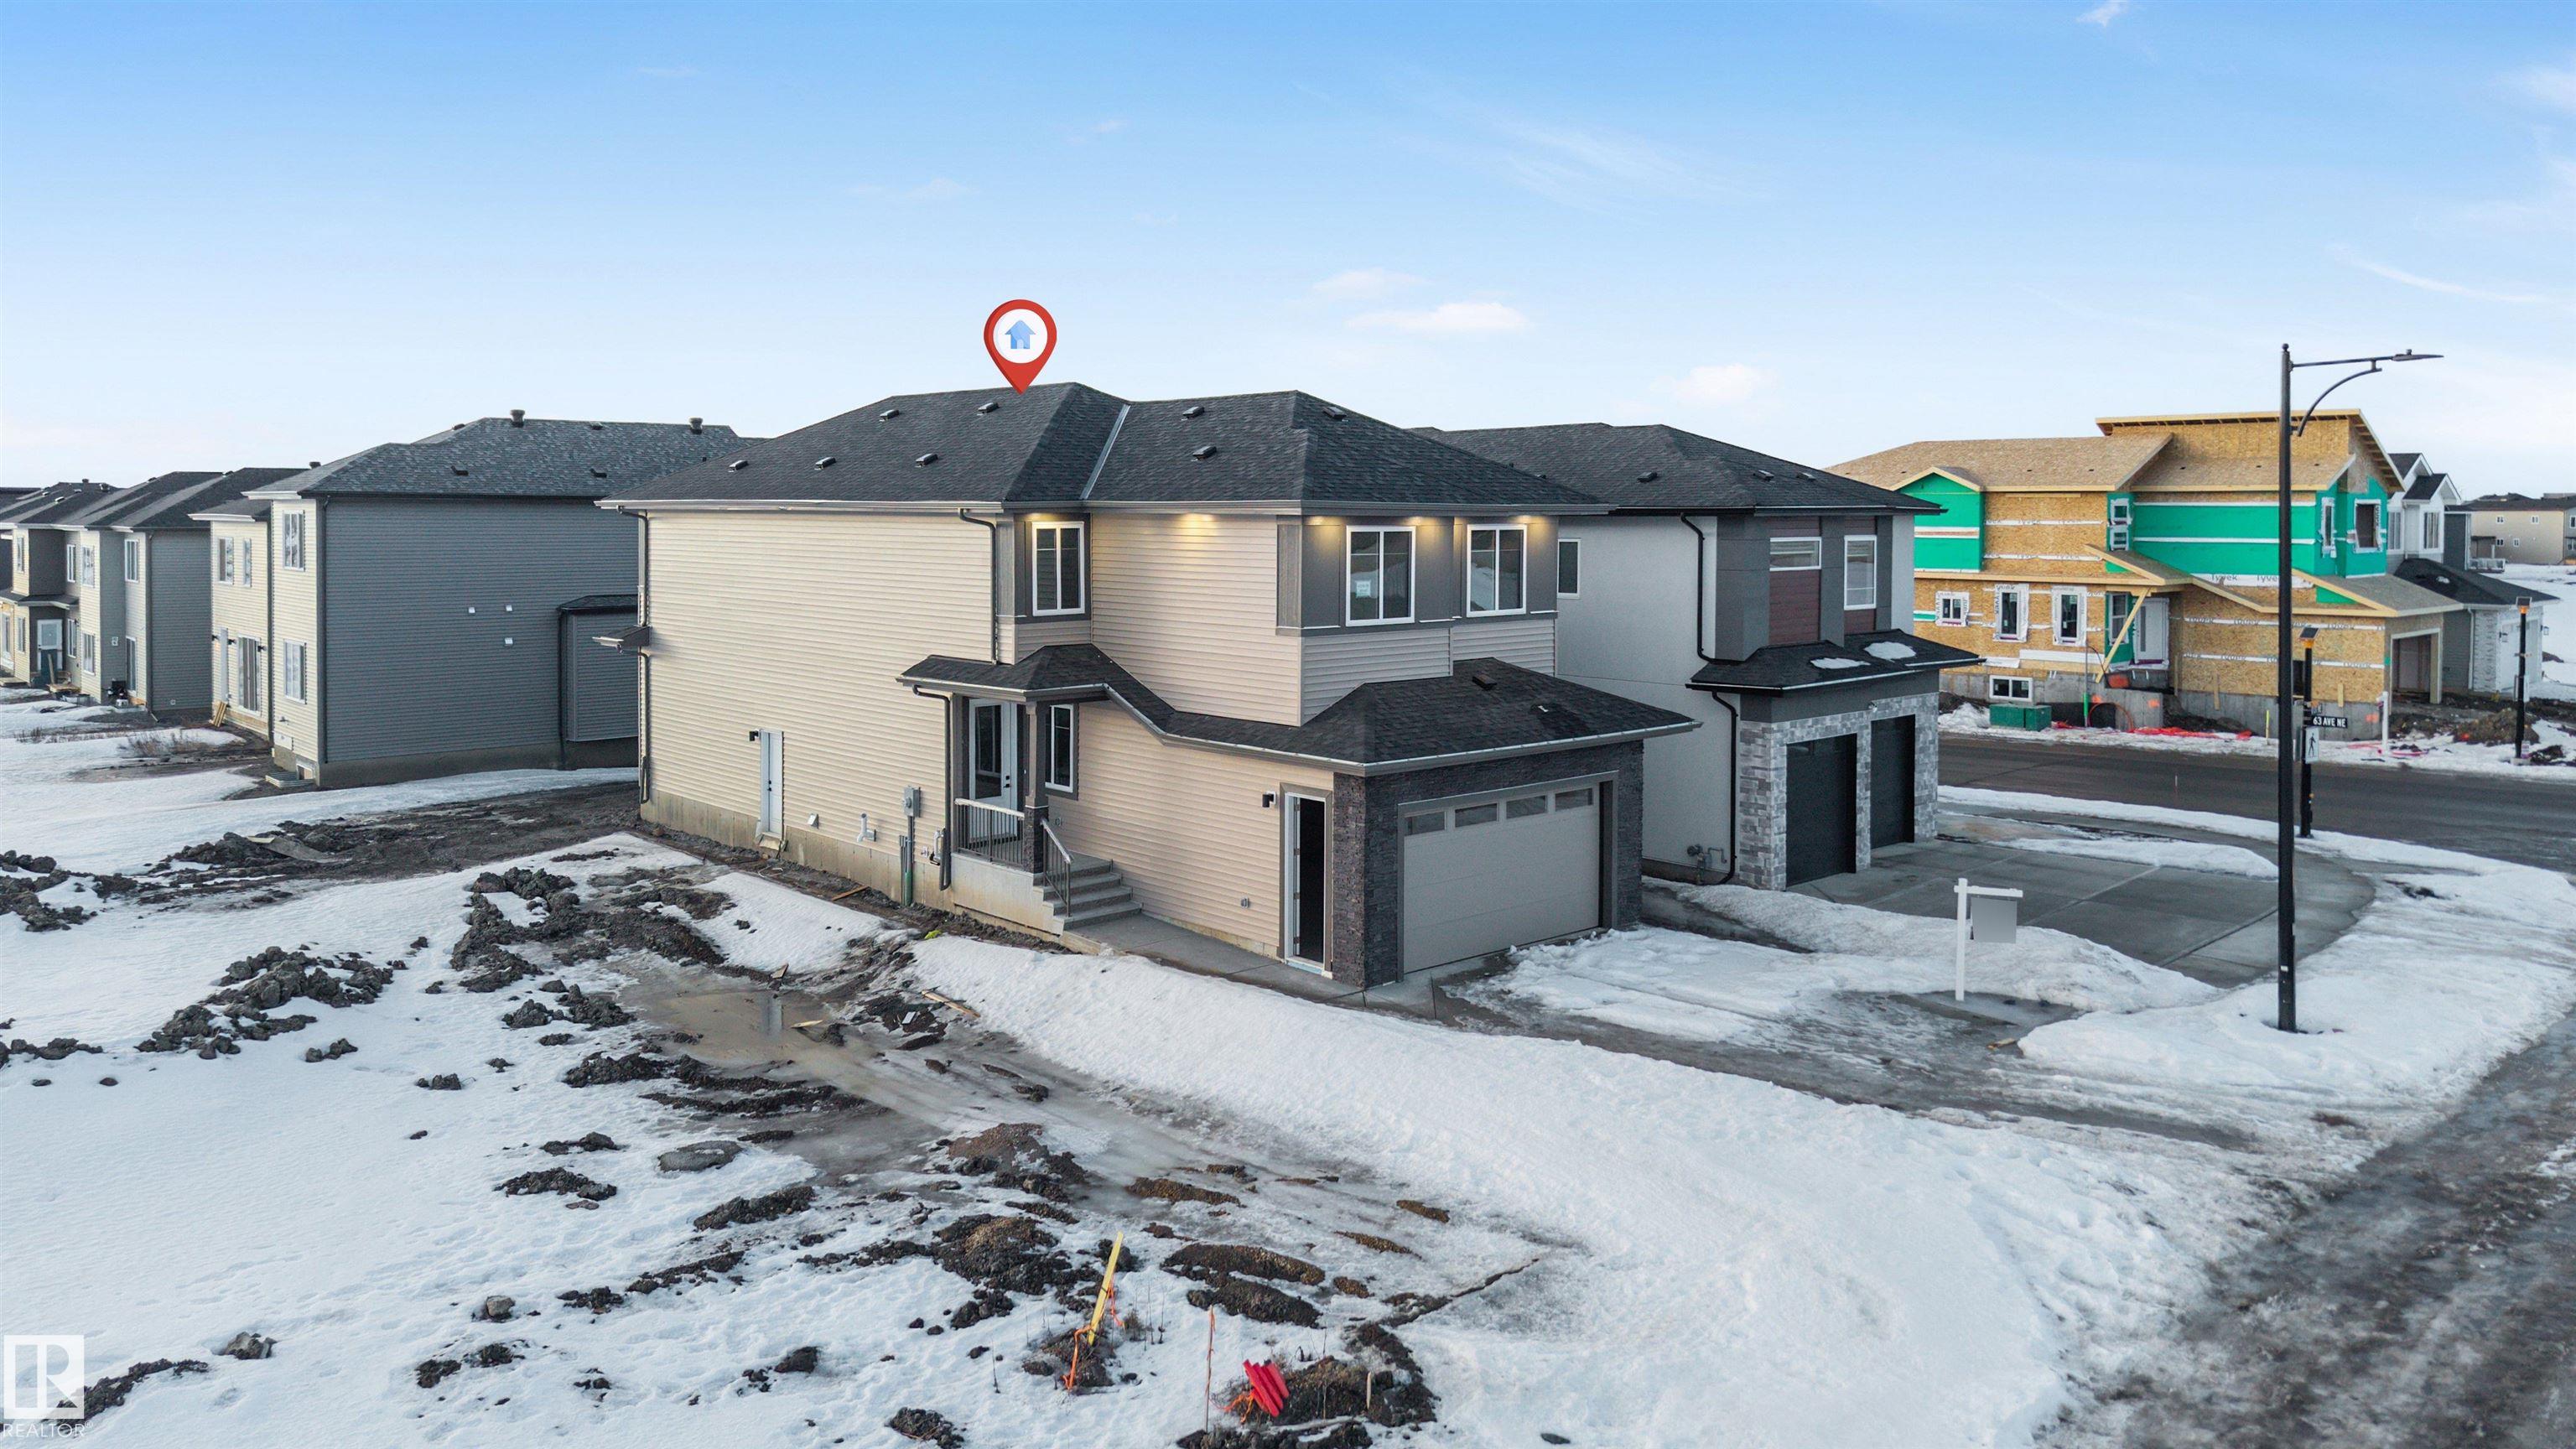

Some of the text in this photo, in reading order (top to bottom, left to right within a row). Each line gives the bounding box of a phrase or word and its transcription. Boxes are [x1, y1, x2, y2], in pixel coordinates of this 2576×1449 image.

[2257, 574, 2279, 583] Tyve
[2313, 716, 2346, 728] 63 AVE NE
